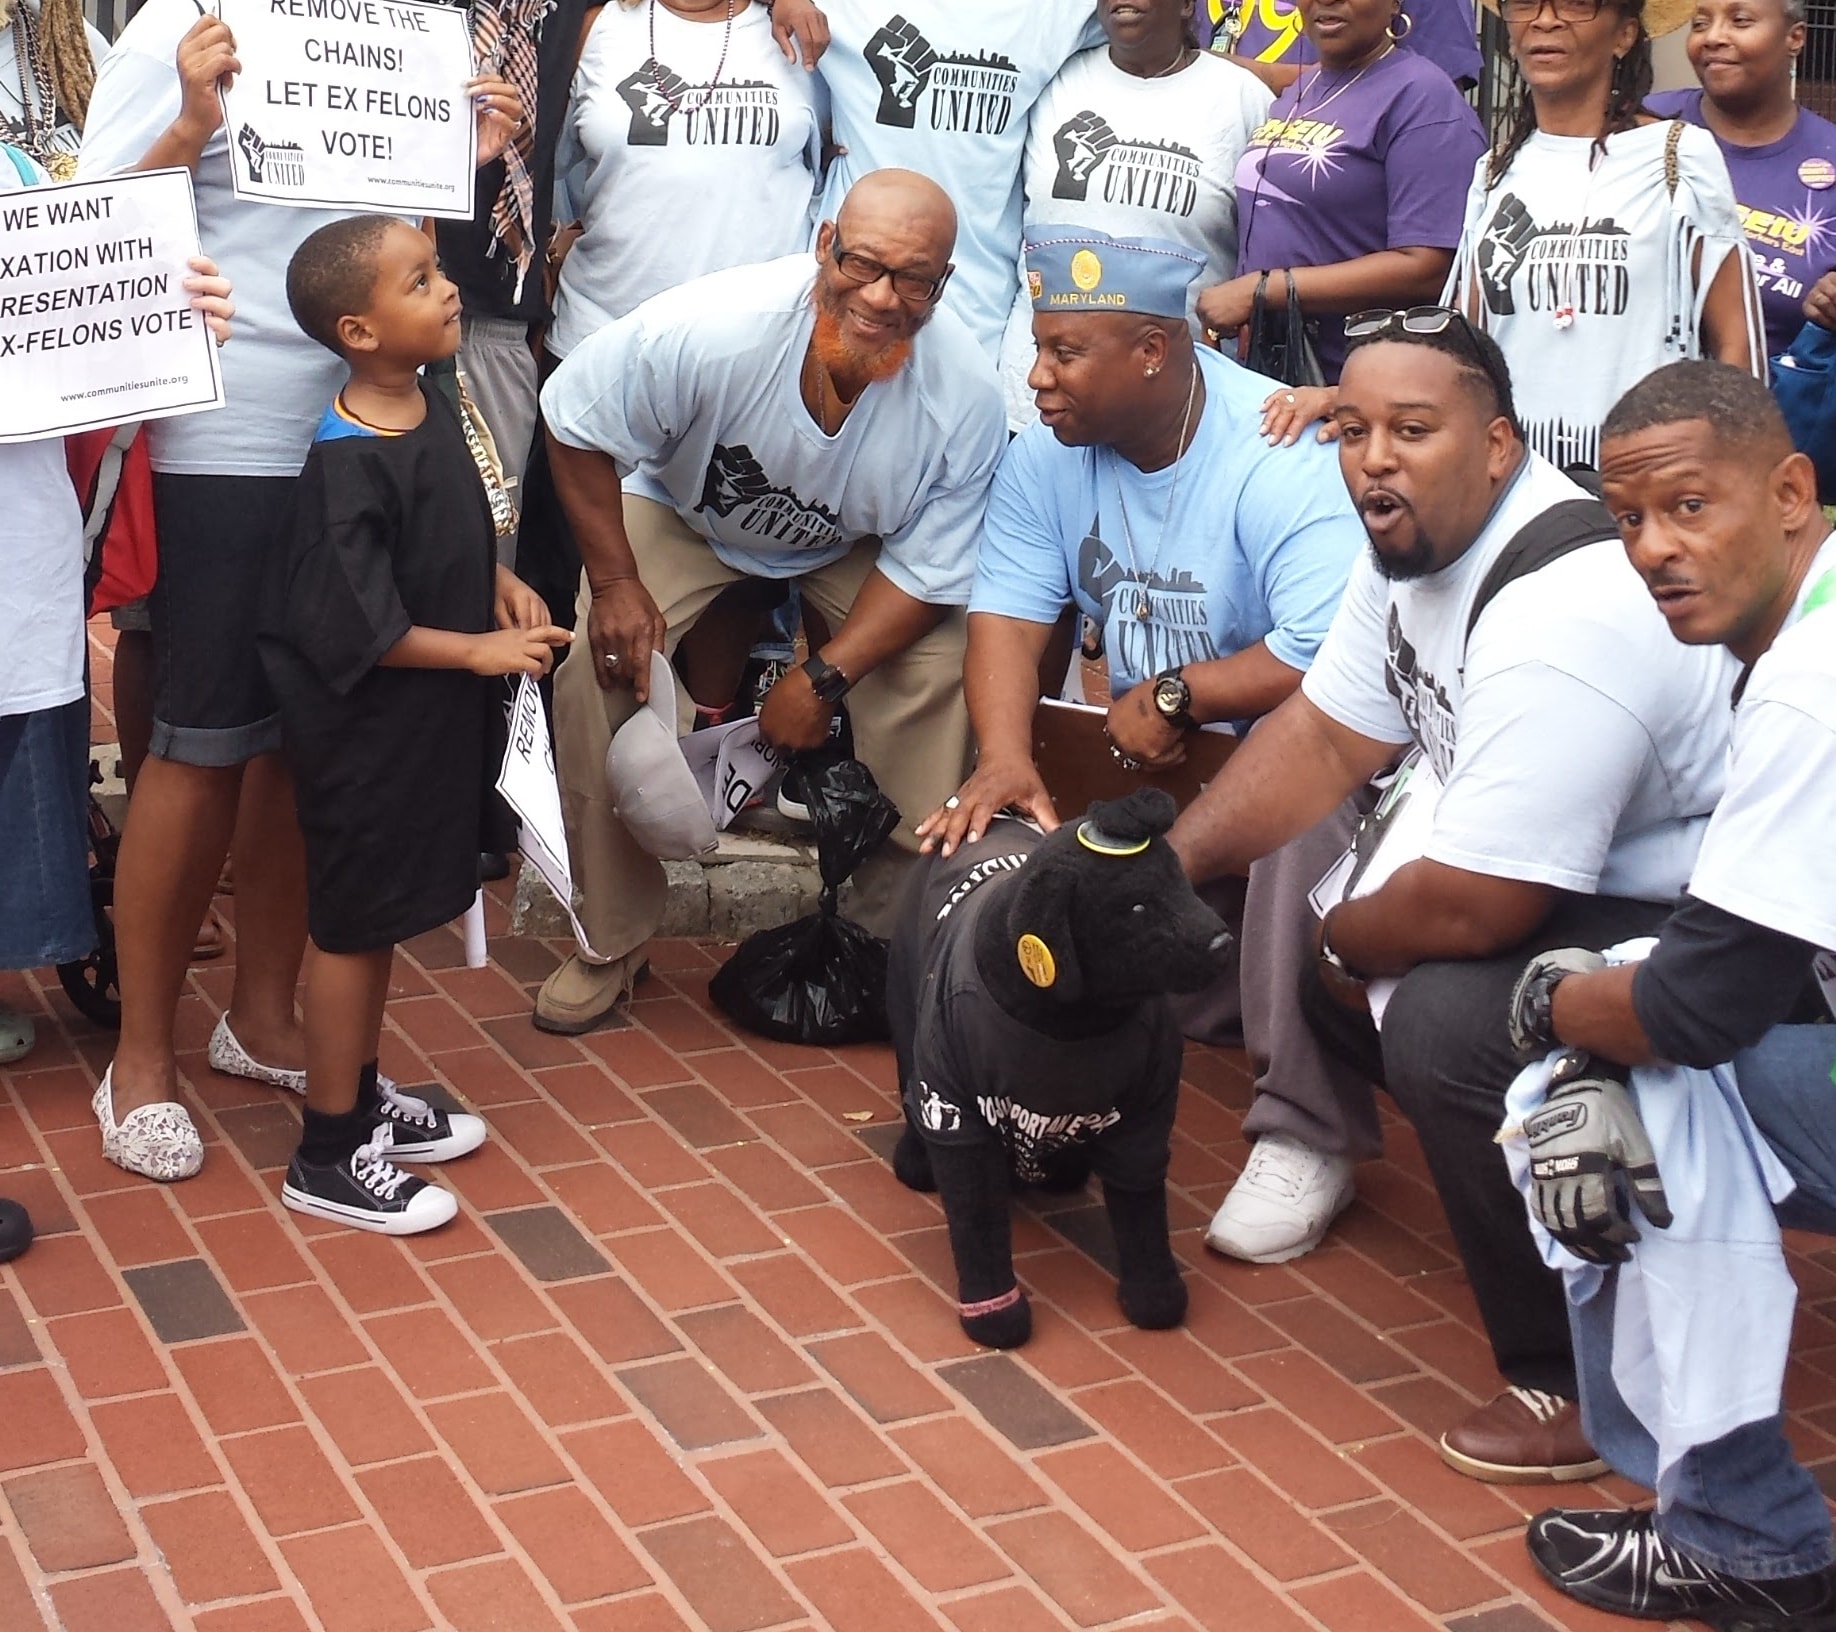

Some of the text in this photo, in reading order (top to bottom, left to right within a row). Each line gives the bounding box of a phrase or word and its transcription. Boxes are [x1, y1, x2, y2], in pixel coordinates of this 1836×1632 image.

[383, 6, 430, 32] THE
[304, 39, 403, 72] CHAINS!
[933, 67, 1018, 93] COMMUNITIES
[266, 80, 451, 122] LET EX FELONS
[931, 88, 1011, 135] UNITED
[686, 106, 780, 146] UNITED
[322, 130, 393, 160] VOTE!
[266, 161, 305, 186] UNITED
[1111, 148, 1201, 178] COMMUNITIES
[1104, 164, 1197, 217] UNITED
[3, 196, 113, 231] WE WANT
[0, 237, 153, 279] XATION WITH
[1, 273, 168, 318] RESENTATION
[1049, 293, 1126, 305] MARYLAND
[1771, 277, 1803, 298] All
[1, 308, 193, 357] X-FELONS VOTE
[61, 375, 189, 402] www.communitiesunite.org
